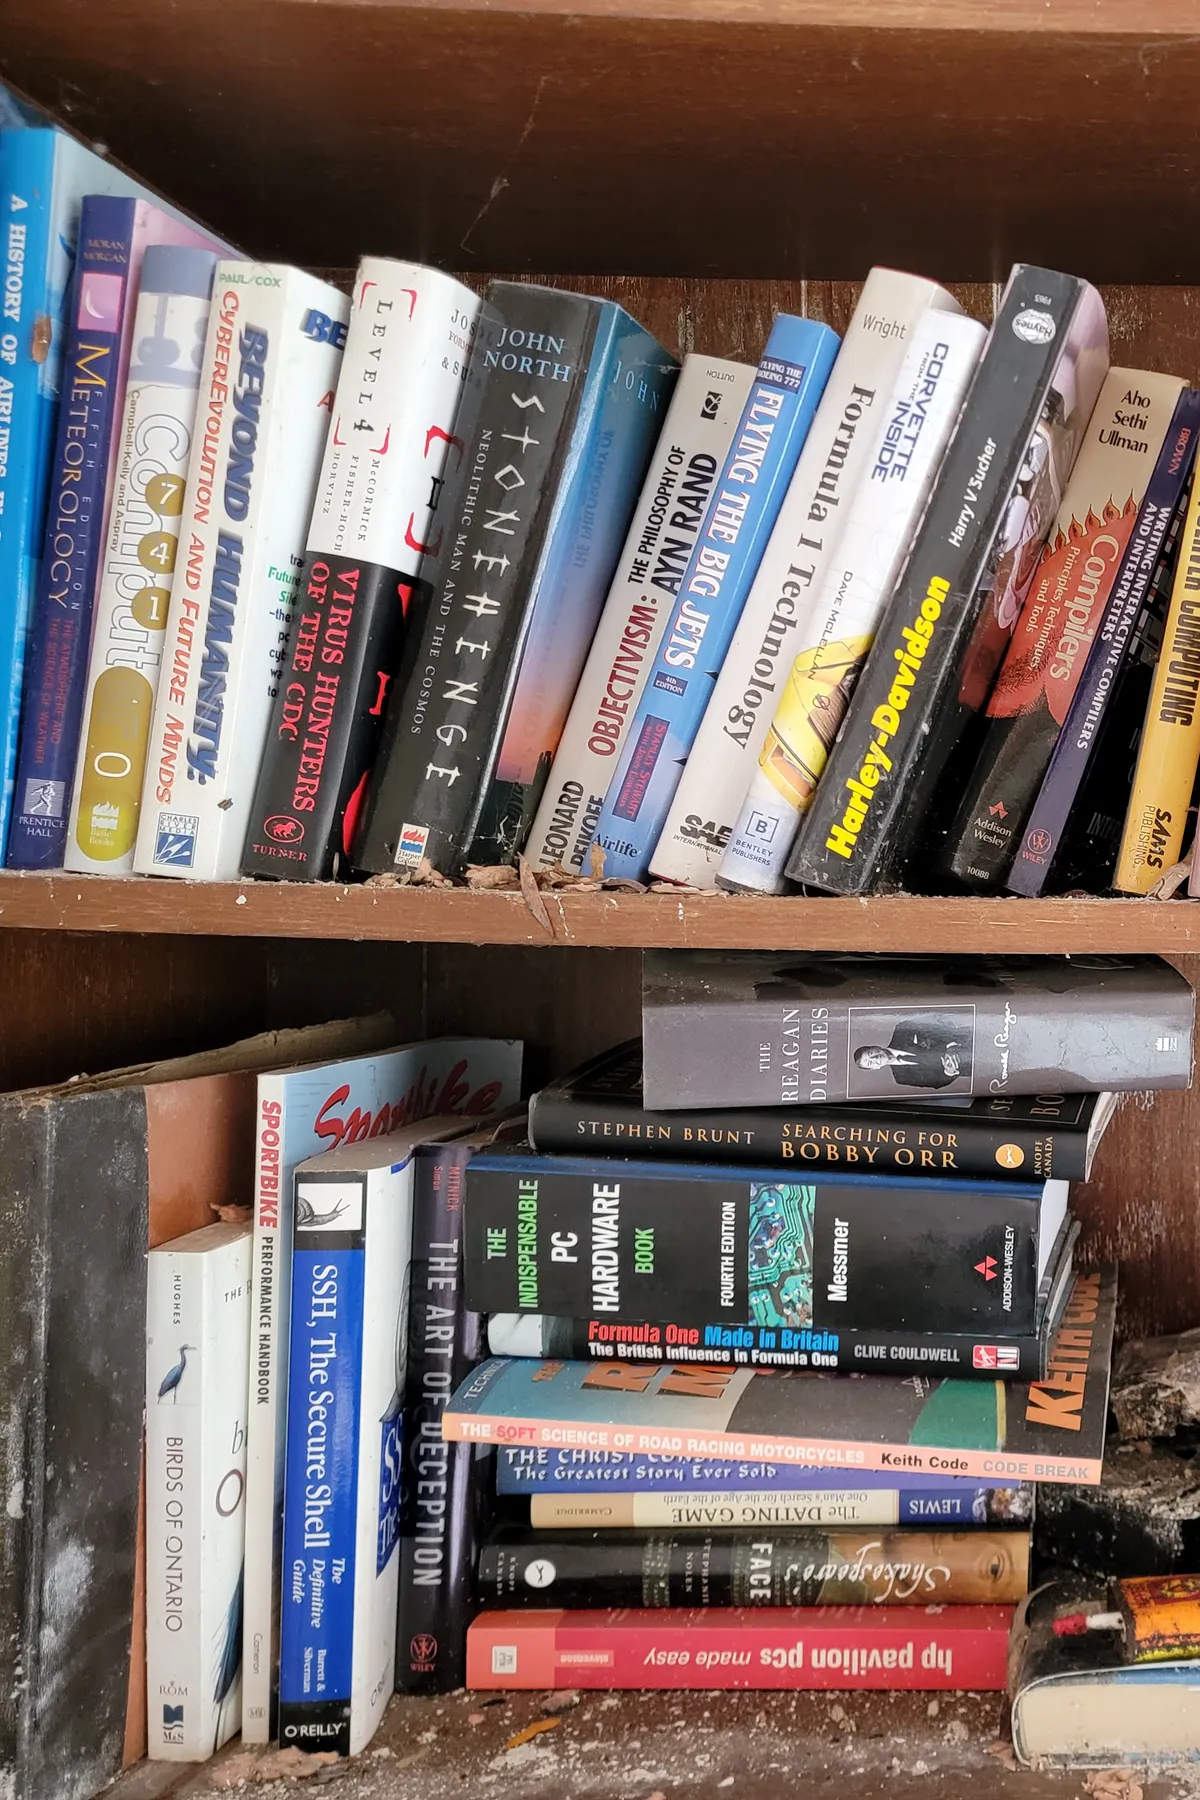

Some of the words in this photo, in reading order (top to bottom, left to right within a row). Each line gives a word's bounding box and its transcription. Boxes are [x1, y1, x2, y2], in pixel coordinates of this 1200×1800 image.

[219, 272, 283, 288] PAUL/COX
[358, 300, 393, 406] LEVEL
[496, 328, 565, 355] JOHN
[862, 314, 906, 339] Wright
[483, 351, 572, 384] NORTH
[705, 369, 735, 382] DUTTON
[223, 322, 269, 522] BEYOND
[890, 342, 949, 481] CORVETTE
[1112, 410, 1149, 431] Sethi
[1121, 390, 1151, 409] Aho
[86, 391, 103, 468] FIFTH
[122, 390, 140, 479] Campbell-Kelly
[728, 388, 785, 484] FLYING
[807, 384, 876, 522] Formula
[872, 400, 905, 482] INSIDE
[1098, 429, 1148, 454] Ullman
[116, 485, 125, 506] and
[333, 454, 359, 552] FISHER-HOCH
[651, 537, 686, 597] AYN
[670, 453, 717, 533] RAND
[706, 491, 750, 544] THE
[71, 497, 91, 610] EDITION
[111, 510, 124, 552] Aspray
[1142, 507, 1171, 570] WRITING
[185, 533, 205, 591] AND
[307, 562, 330, 605] OF
[687, 545, 731, 598] BIG
[321, 569, 360, 664] VIRUS
[664, 598, 711, 669] JETS
[1050, 534, 1119, 682] Compilers
[1107, 572, 1149, 667] INTERACTIVE
[167, 598, 200, 705] FUTURE
[292, 612, 321, 672] THE
[723, 563, 816, 749] Technology
[588, 594, 658, 756] OBJECTIVISM:
[279, 683, 307, 742] CDC
[825, 575, 951, 859] Harley-Davidson
[1077, 667, 1116, 750] COMPILERS
[155, 713, 185, 806] MINDS
[293, 673, 340, 812] HUNTERS
[252, 844, 308, 862] TURNER
[539, 780, 585, 868] LEONARD
[735, 839, 774, 857] BENTLEY
[1147, 808, 1171, 869] SAMS
[731, 849, 772, 867] PUBLISHERS
[966, 866, 990, 880] 10088
[781, 1007, 800, 1102] REAGAN
[809, 1007, 829, 1101] DIARIES
[258, 1099, 281, 1229] SPORTBIKE
[781, 1123, 907, 1145] SEARCHING
[918, 1131, 959, 1148] FOR
[781, 1140, 880, 1164] BOBBY
[894, 1147, 960, 1169] ORR
[427, 1239, 459, 1292] THE
[518, 1179, 538, 1308] INDISPENSABLE
[551, 1231, 578, 1263] PC
[592, 1183, 620, 1312] HARDWARE
[635, 1228, 655, 1274] BOOK
[1002, 1225, 1015, 1312] ADDISON-WESLEY
[260, 1237, 273, 1329] PERFORMANCE
[305, 1264, 338, 1327] SSH,
[310, 1335, 337, 1384] The
[425, 1304, 454, 1359] ART
[588, 1321, 660, 1344] Formula
[666, 1324, 699, 1345] One
[704, 1326, 753, 1348] Made
[759, 1327, 775, 1349] in
[781, 1329, 839, 1352] Britain
[854, 1344, 887, 1360] CLIVE
[889, 1345, 960, 1363] COULDWELL
[257, 1333, 272, 1405] HANDBOOK
[421, 1367, 450, 1405] OF
[307, 1387, 334, 1481] Secure
[461, 1422, 491, 1438] THE
[497, 1425, 536, 1440] SOFT
[541, 1428, 608, 1446] SCIENCE
[613, 1433, 634, 1447] OF
[639, 1436, 682, 1450] ROAD
[687, 1439, 745, 1456] RACING
[750, 1443, 865, 1463] MOTORCYCLES
[881, 1452, 923, 1467] Keith
[929, 1456, 969, 1471] Code
[165, 1437, 183, 1492] BIRDS
[165, 1501, 183, 1529] OF
[303, 1484, 331, 1551] Shell
[412, 1422, 448, 1587] DECEPTION
[909, 1500, 961, 1514] LEWIS
[165, 1538, 183, 1633] ONTARIO
[643, 1647, 690, 1665] easy
[696, 1650, 751, 1669] made
[760, 1642, 803, 1666] pcs
[811, 1642, 913, 1676] pavilion
[921, 1643, 952, 1675] hp
[284, 1723, 346, 1738] O'REILLY
